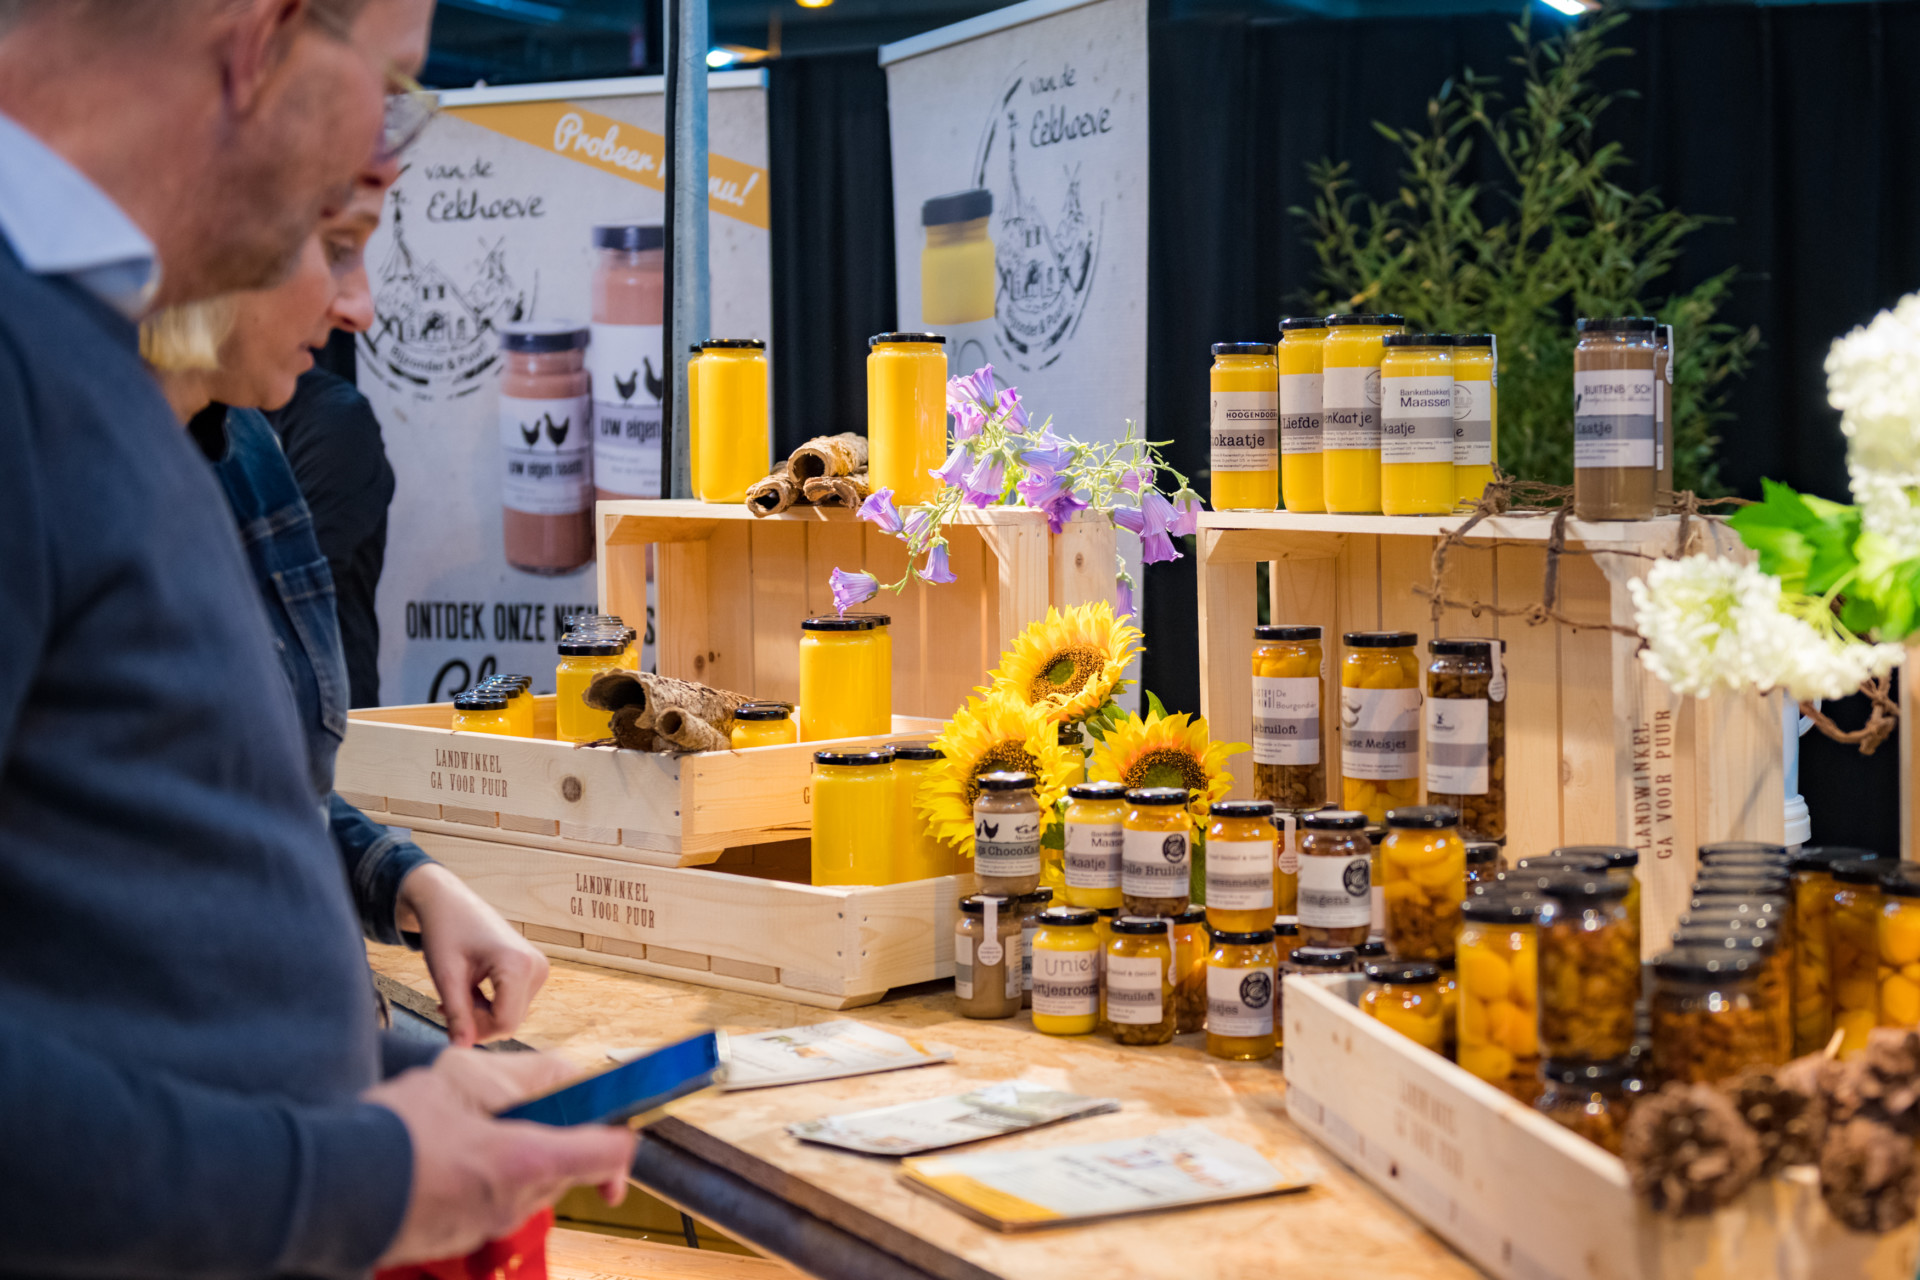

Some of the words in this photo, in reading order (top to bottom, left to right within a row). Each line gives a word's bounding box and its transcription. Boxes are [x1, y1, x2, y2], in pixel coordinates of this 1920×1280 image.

[554, 112, 655, 173] Probeer
[1400, 397, 1451, 408] Maassen
[625, 418, 661, 444] eigen
[1282, 416, 1320, 430] Liefde
[1381, 422, 1416, 437] kaatje
[1210, 434, 1265, 449] okaatje
[527, 460, 553, 480] eigen
[405, 601, 486, 641] ONTDEK
[493, 602, 546, 643] ONZE
[1365, 737, 1407, 752] Meisjes
[1655, 710, 1672, 760] PUUR
[435, 748, 502, 774] LANDWINKEL
[430, 771, 443, 790] GA
[449, 773, 476, 794] VOOR
[482, 776, 509, 798] PUUR
[1633, 722, 1652, 850] LANDWINKEL
[1655, 774, 1673, 823] VOOR
[1656, 836, 1674, 860] GA
[1068, 859, 1106, 872] kaatje
[576, 872, 649, 903] LANDWINKEL
[570, 896, 584, 917] GA
[591, 899, 620, 923] VOOR
[626, 905, 655, 929] PUUR
